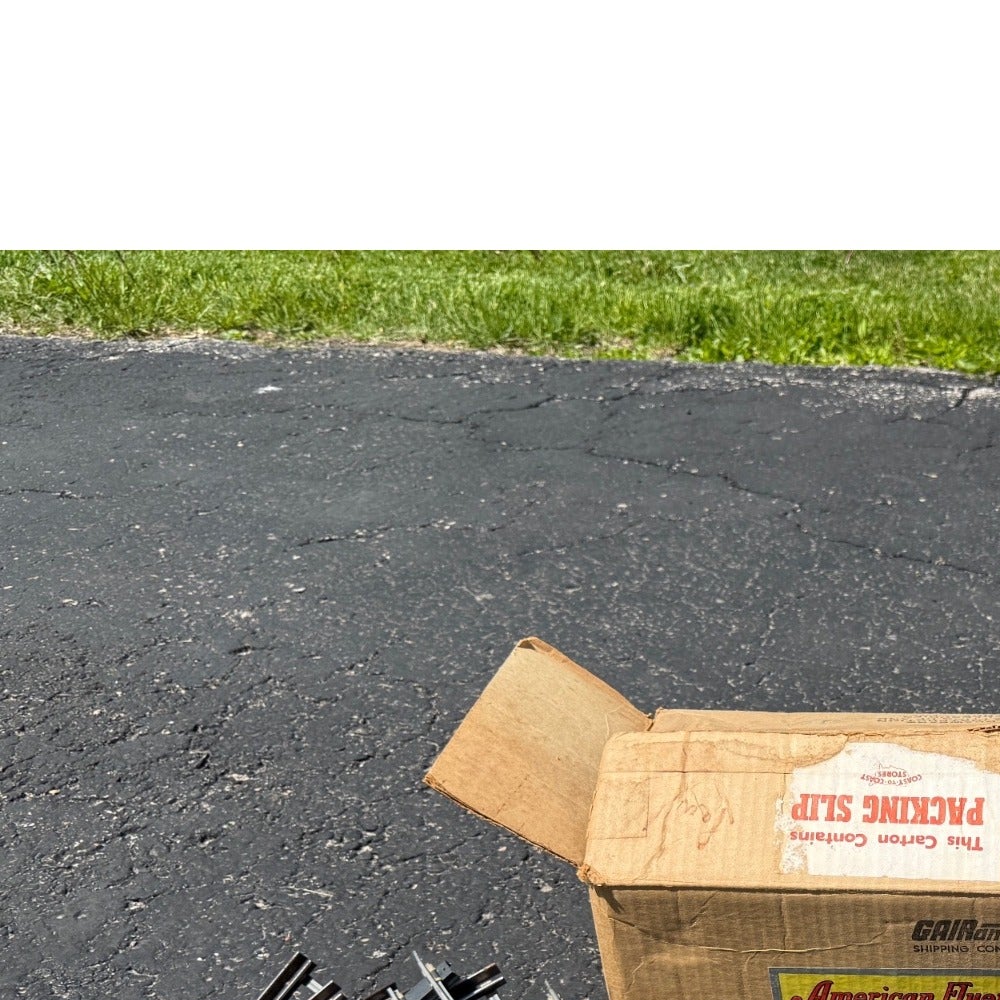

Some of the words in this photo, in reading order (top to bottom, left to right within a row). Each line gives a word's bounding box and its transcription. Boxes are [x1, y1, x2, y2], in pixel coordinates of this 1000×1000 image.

[791, 793, 854, 822] SLIP
[862, 795, 985, 826] PACKING
[789, 831, 868, 848] Contains
[877, 834, 938, 850] Carton
[947, 836, 983, 852] This
[913, 945, 970, 953] SHIPPING
